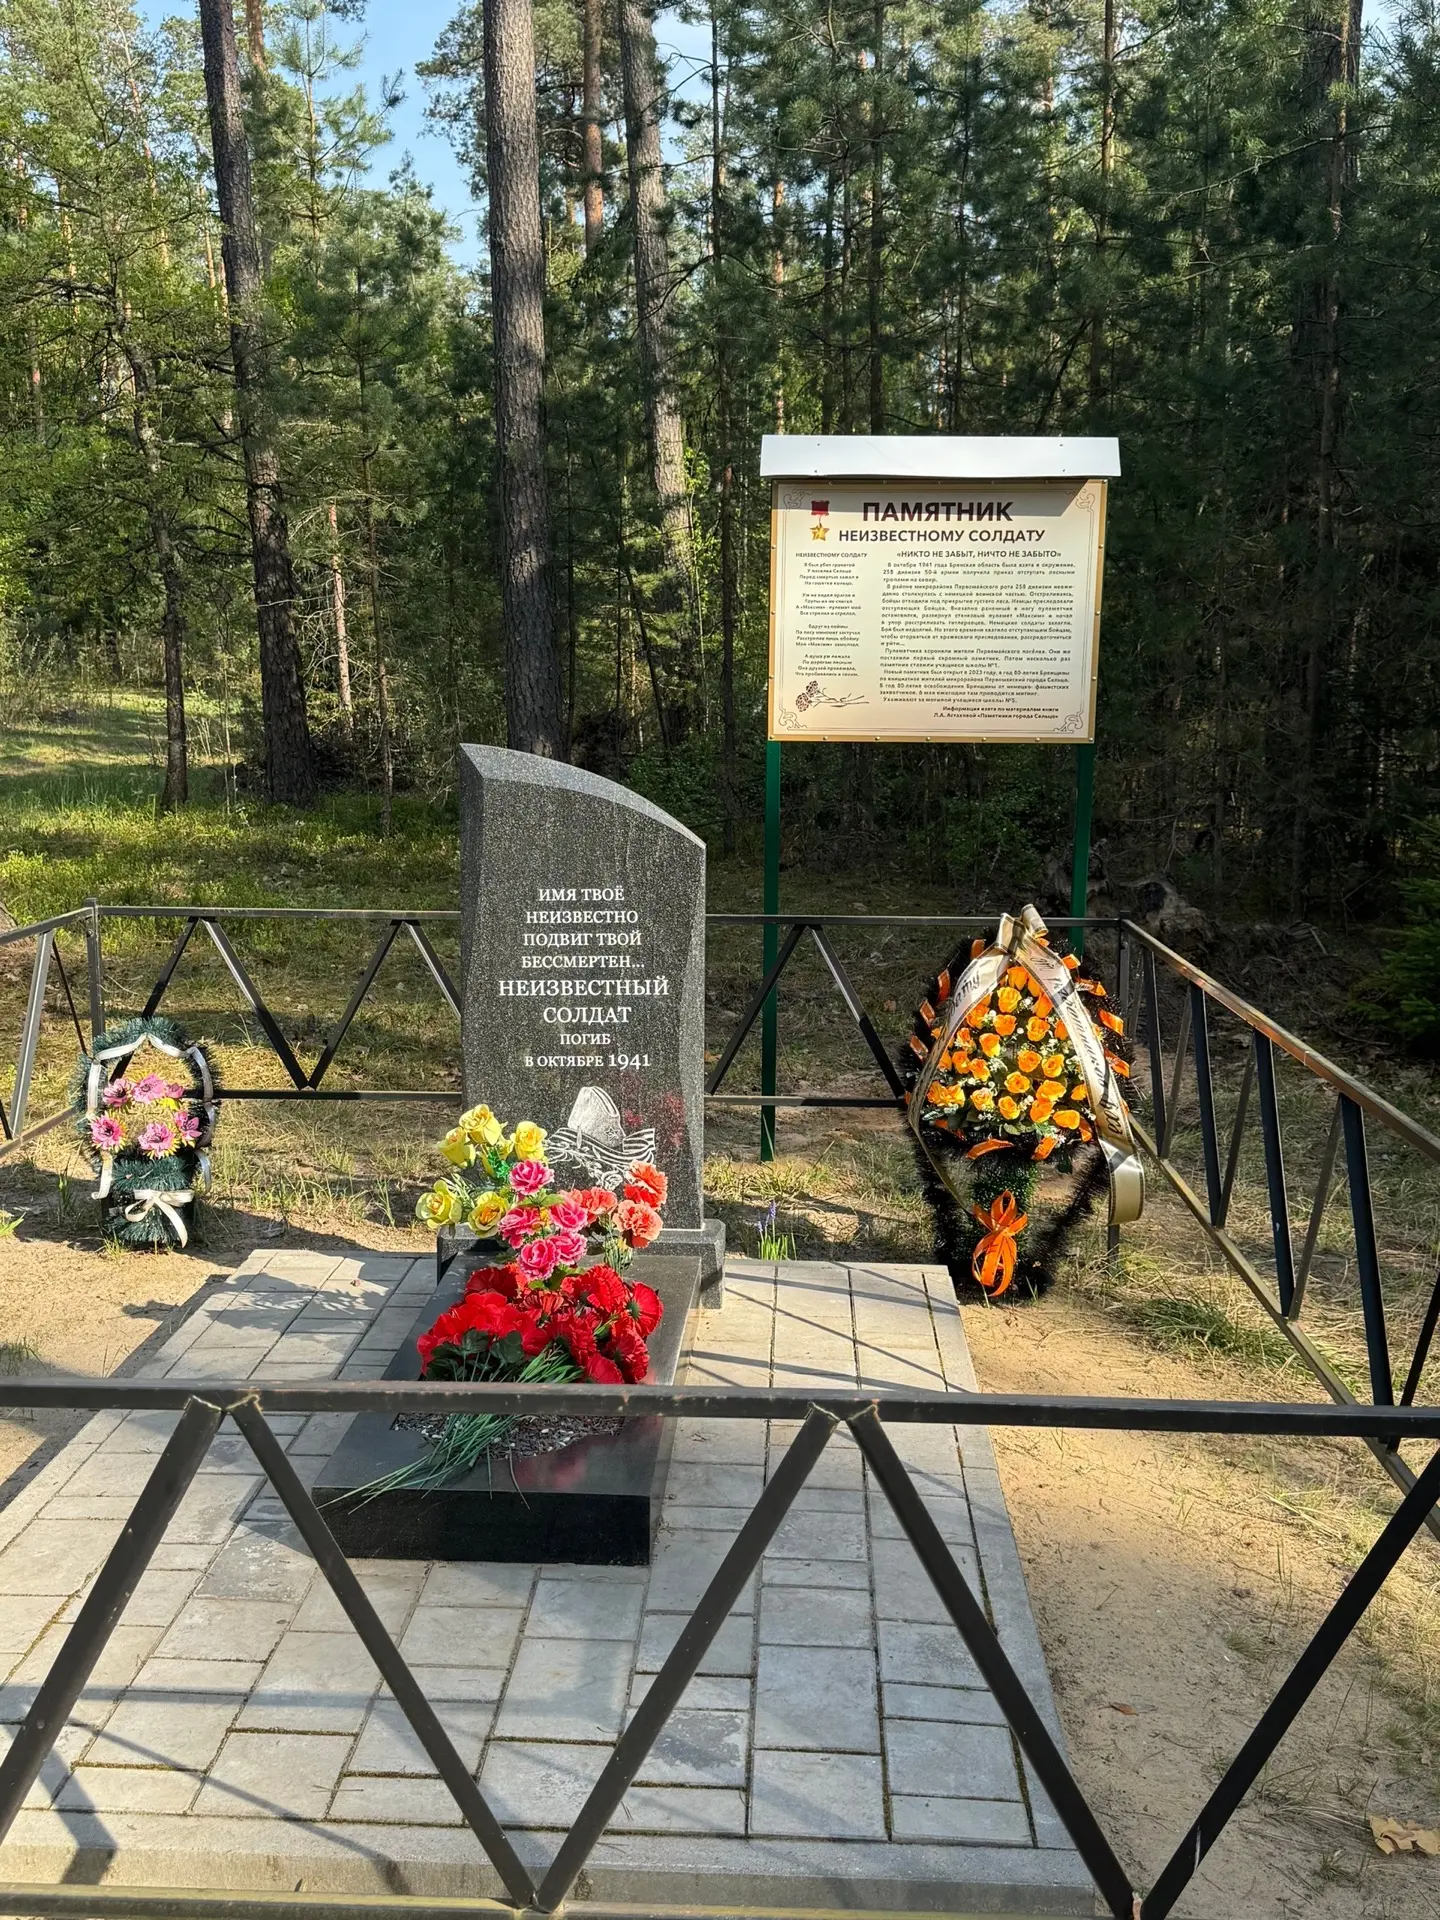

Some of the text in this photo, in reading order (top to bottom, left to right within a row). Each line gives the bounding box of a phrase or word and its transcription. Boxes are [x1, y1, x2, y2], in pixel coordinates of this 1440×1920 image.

[862, 502, 1013, 522] ПАМЯТНИК
[838, 530, 1045, 544] НЕИЗВЕСТНОМУ СОЛДАТУ
[539, 886, 624, 901] ИМЯ ТВОЁ
[526, 911, 638, 923] НЕИЗВЕСТНО
[524, 930, 641, 948] ПОДВИГ ТВОЙ
[522, 956, 645, 968] БЕССМЕРТЕН...
[499, 976, 669, 996] НЕИЗВЕСТНЫЙ
[543, 1007, 632, 1025] СОЛДАТ
[560, 1034, 611, 1045] ПОГИБ
[525, 1055, 650, 1070] В ОКТЯБРЕ 1941
